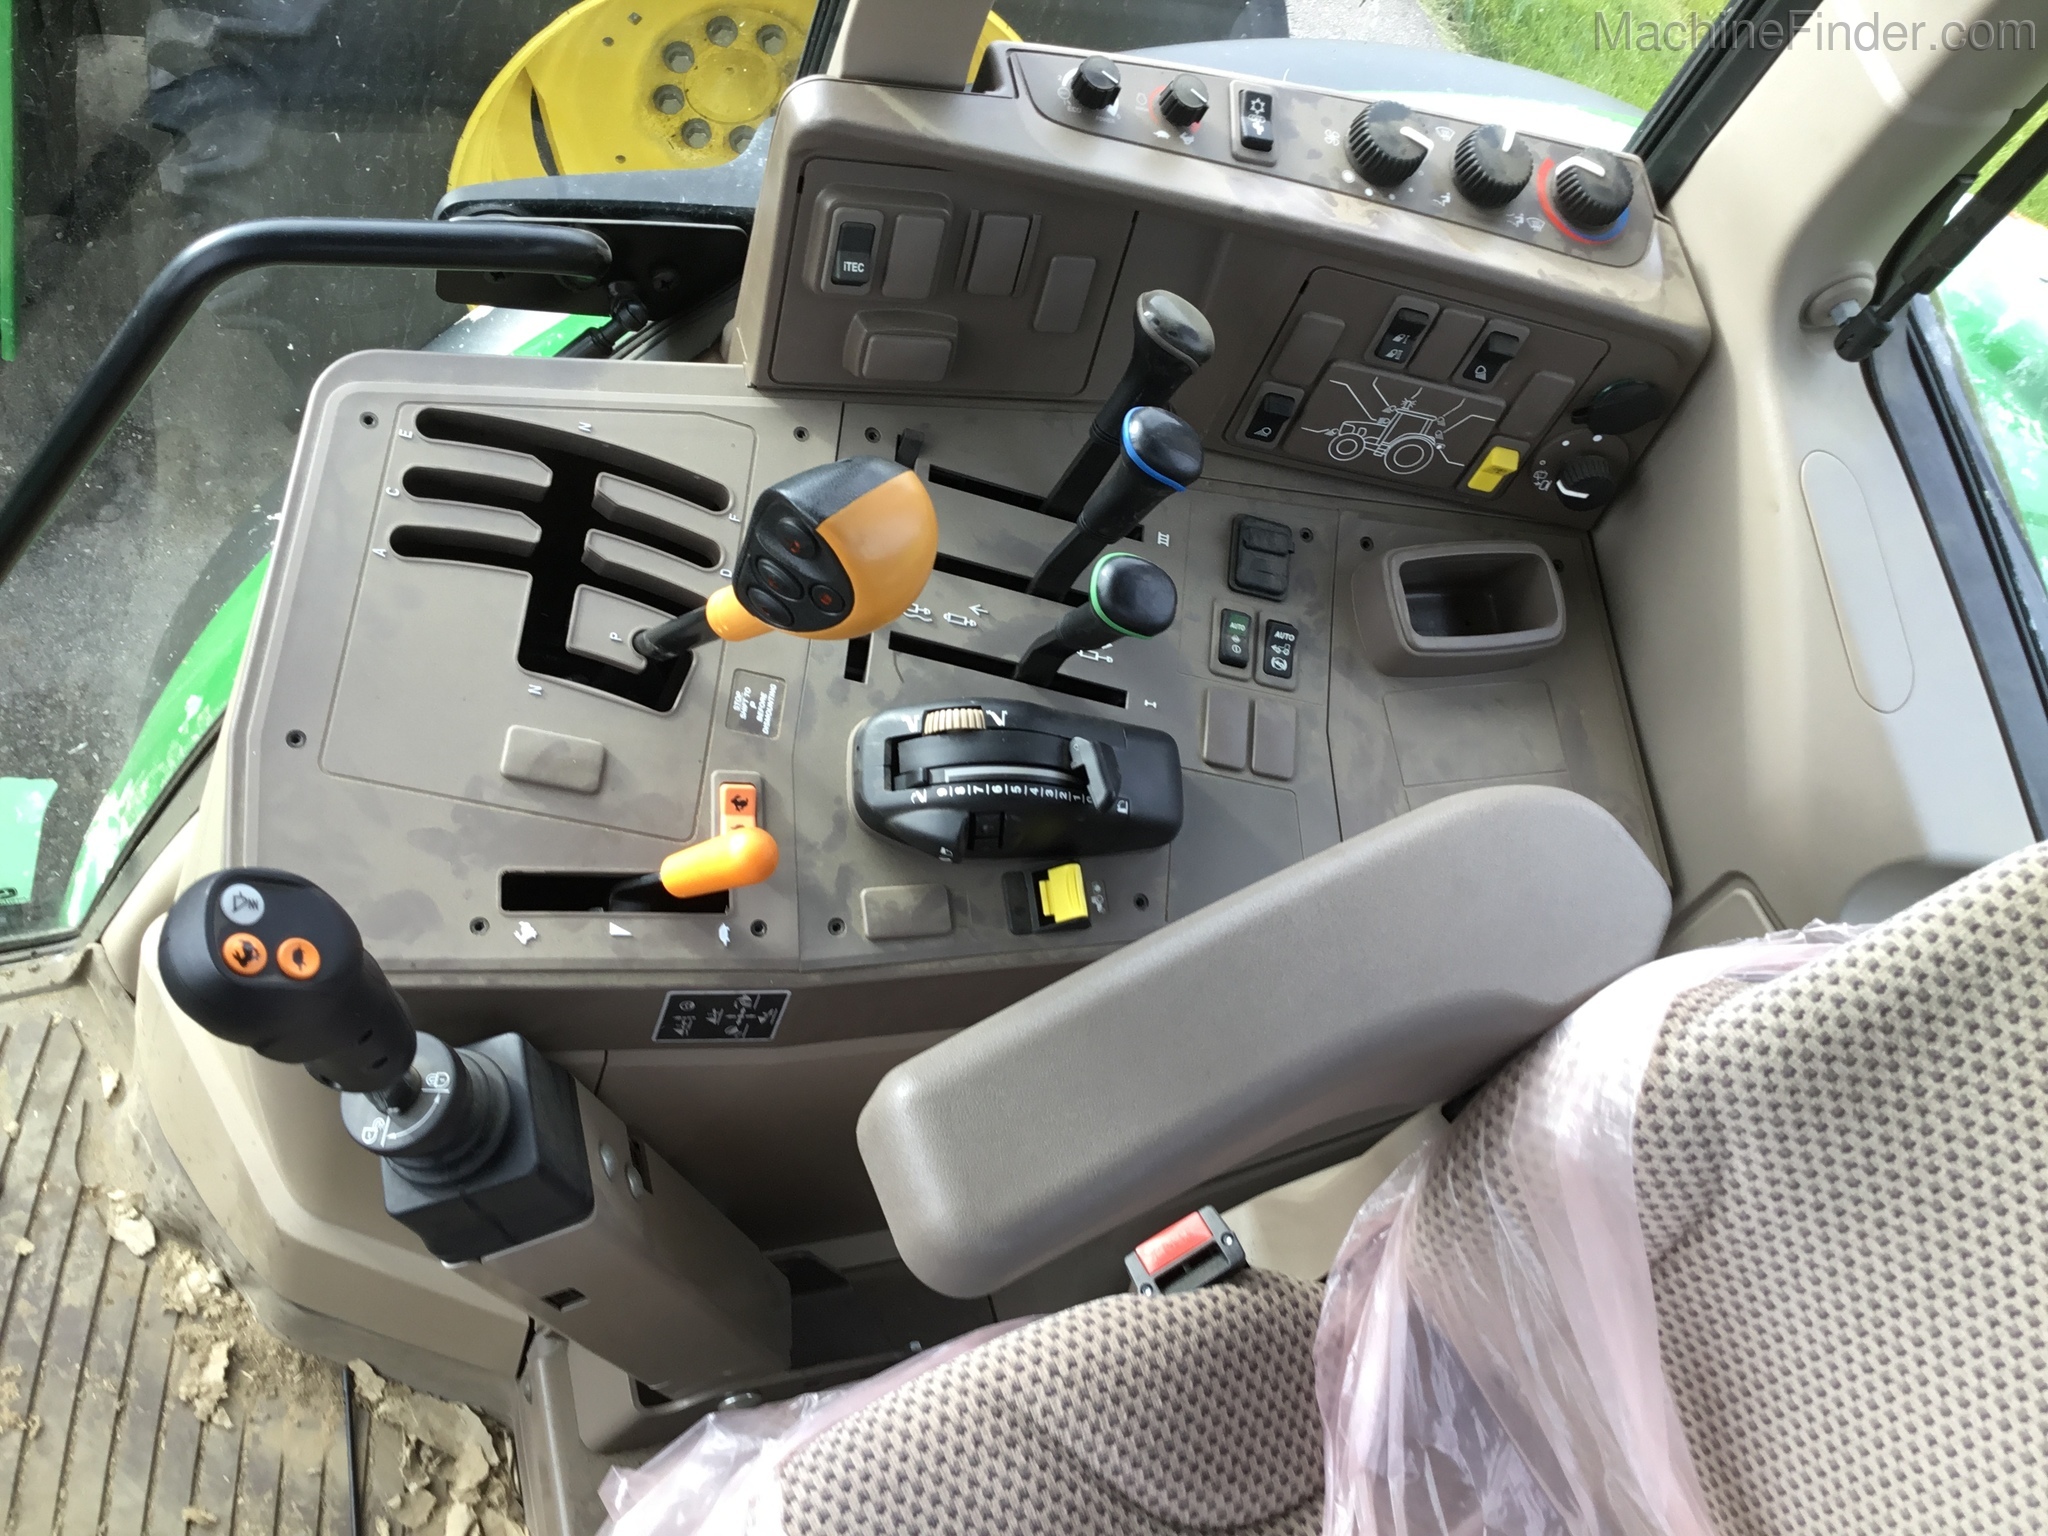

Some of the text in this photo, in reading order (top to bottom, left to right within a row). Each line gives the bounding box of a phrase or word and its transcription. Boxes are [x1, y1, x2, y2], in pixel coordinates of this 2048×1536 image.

[578, 421, 592, 433] N
[398, 428, 413, 439] E
[386, 486, 400, 497] C
[728, 512, 741, 523] F
[372, 547, 387, 558] A
[719, 568, 733, 578] D
[1229, 621, 1246, 632] AUTO
[609, 631, 623, 643] P
[1273, 630, 1296, 642] AUTO
[527, 684, 543, 696] N
[749, 700, 757, 710] P
[972, 785, 984, 795] 7
[991, 784, 1003, 794] 6
[1010, 784, 1022, 795] 5
[1029, 786, 1040, 797] 4
[1045, 788, 1055, 798] 3
[1058, 790, 1068, 801] 2
